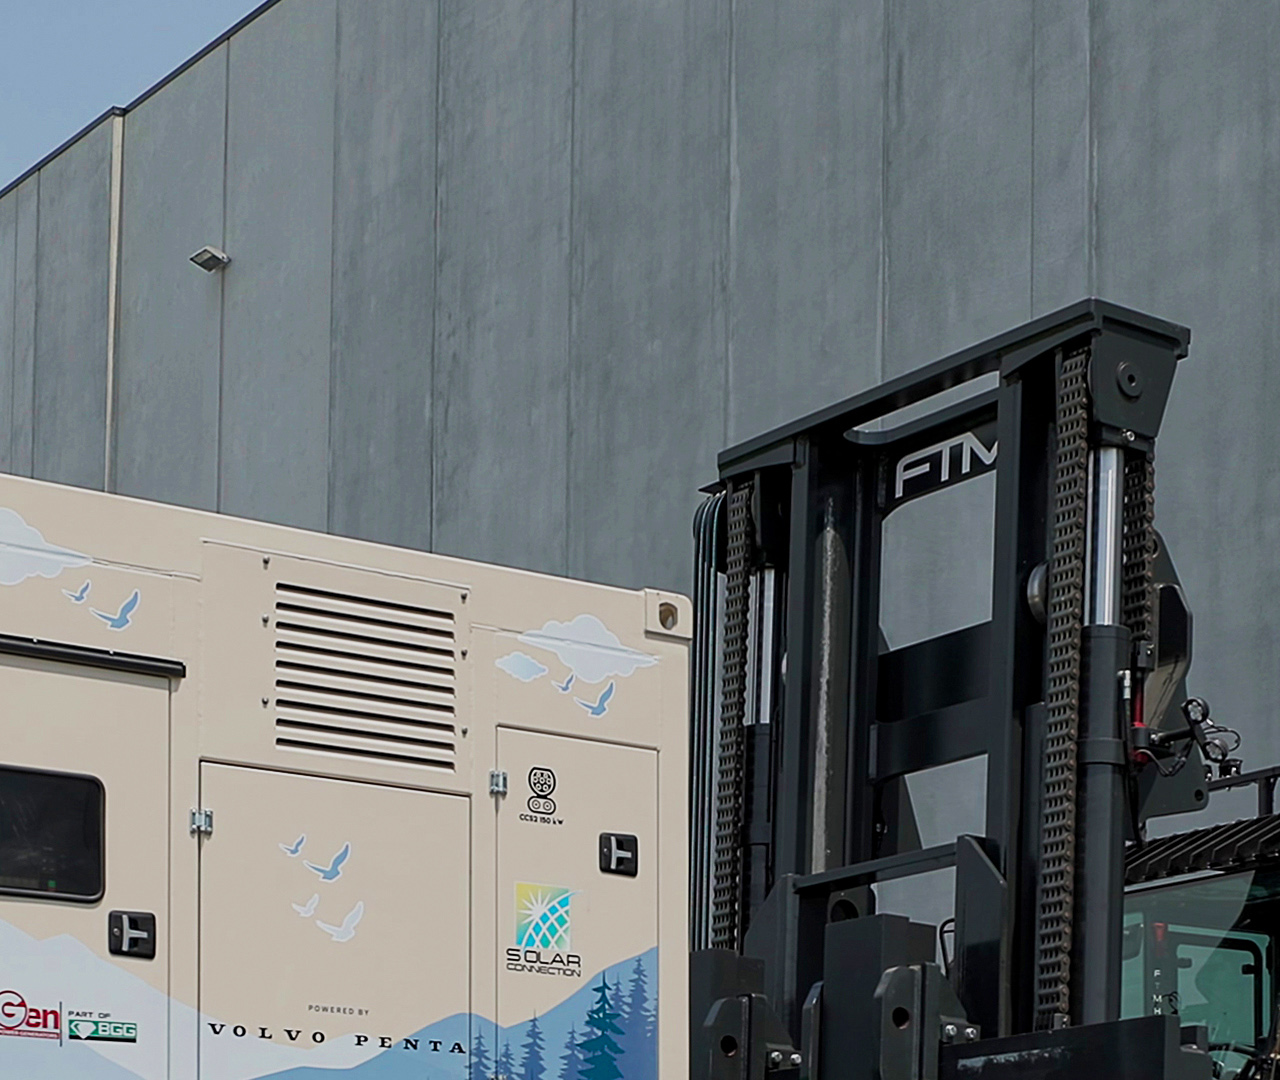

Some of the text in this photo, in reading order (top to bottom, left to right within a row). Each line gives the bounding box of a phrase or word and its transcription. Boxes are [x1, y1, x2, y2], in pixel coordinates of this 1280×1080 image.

[895, 431, 999, 499] FTM
[506, 948, 581, 968] SOLAR
[506, 962, 581, 978] CONNECTION
[68, 1010, 93, 1018] PART
[308, 1004, 369, 1016] POWERED BY
[98, 1022, 137, 1037] BGG
[208, 1022, 467, 1055] VOLVO PENTA
